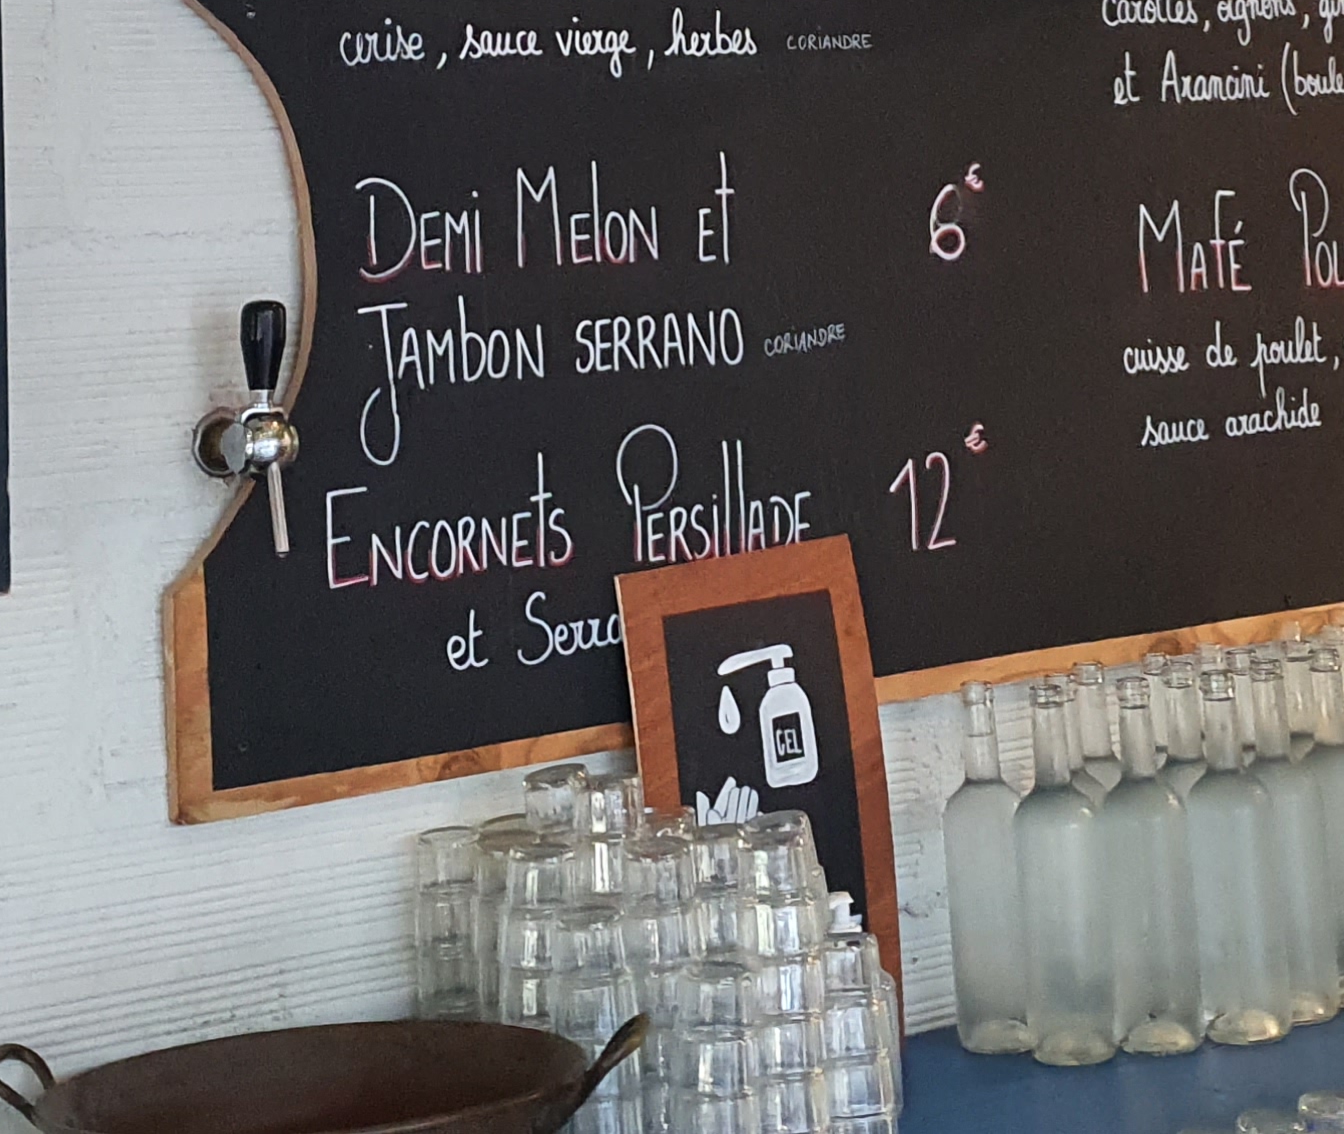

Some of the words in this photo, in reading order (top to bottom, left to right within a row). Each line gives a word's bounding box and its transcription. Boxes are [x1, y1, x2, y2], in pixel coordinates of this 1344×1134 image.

[459, 22, 543, 60] sauce
[664, 6, 757, 57] herbes
[786, 31, 872, 51] CORIANDRE
[1113, 51, 1139, 104] et
[1161, 50, 1270, 104] Arancini
[575, 307, 744, 374] SERRANO
[763, 322, 846, 357] CORIANDRE
[1123, 336, 1190, 374] cuisse
[1206, 321, 1237, 367] de
[1141, 412, 1210, 448] sauce
[1225, 387, 1322, 438] arachide
[447, 608, 486, 670] et
[516, 591, 622, 666] Serra
